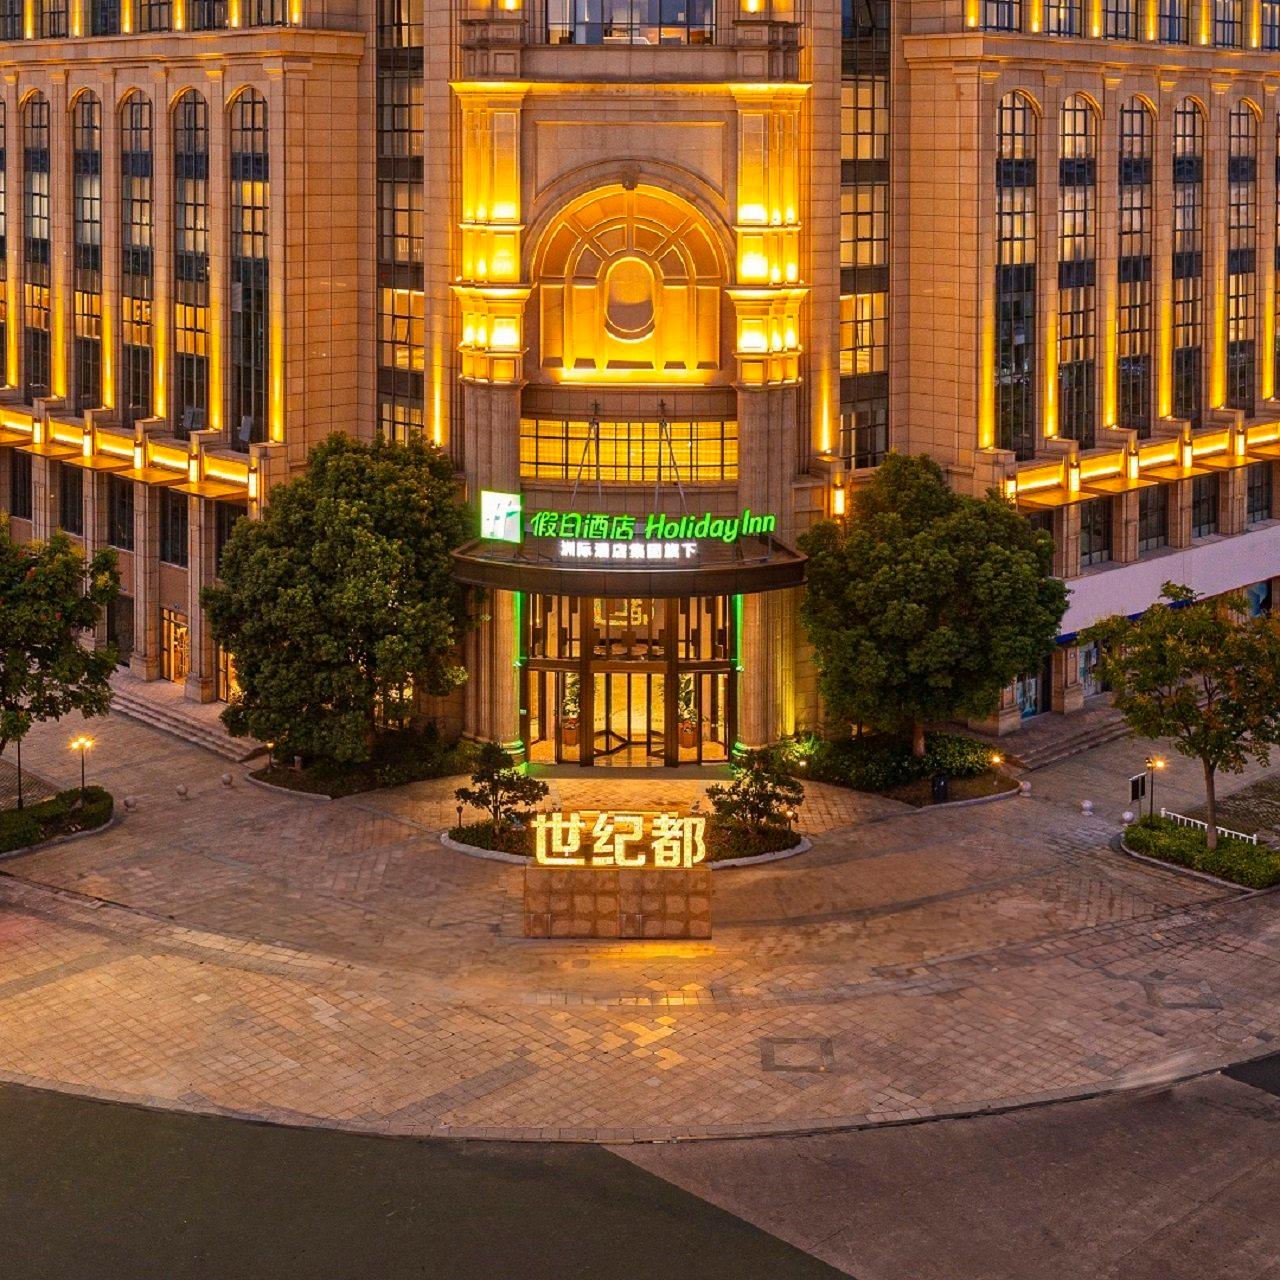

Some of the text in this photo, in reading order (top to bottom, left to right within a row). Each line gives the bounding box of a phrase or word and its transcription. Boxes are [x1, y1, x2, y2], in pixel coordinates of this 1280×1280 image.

[531, 509, 776, 543] 假日酒店 Holiday Inn
[531, 813, 706, 869] 世纪都
